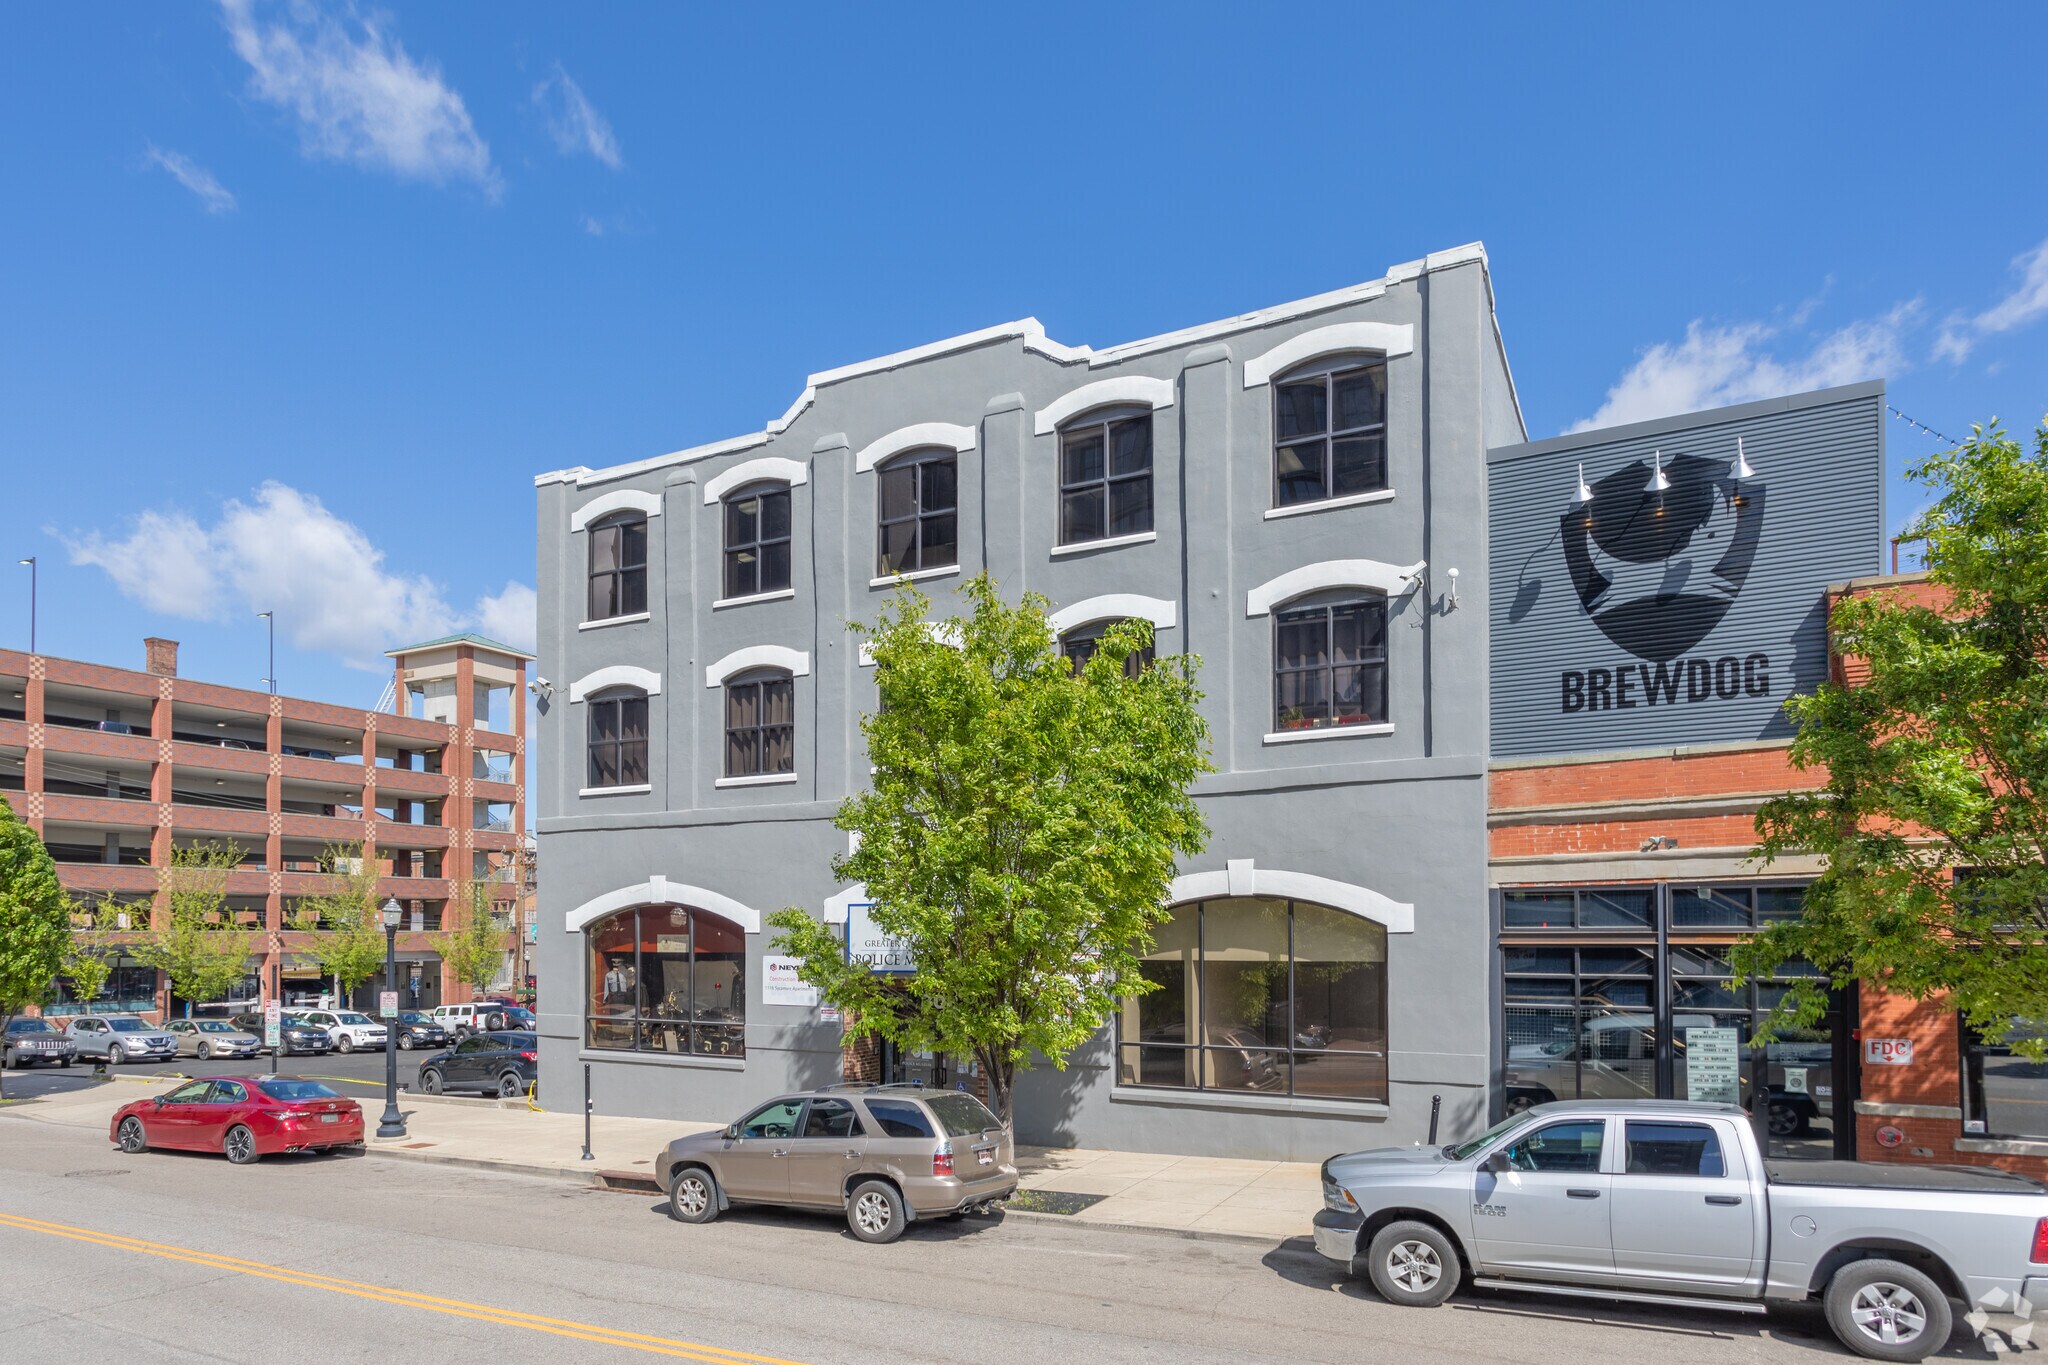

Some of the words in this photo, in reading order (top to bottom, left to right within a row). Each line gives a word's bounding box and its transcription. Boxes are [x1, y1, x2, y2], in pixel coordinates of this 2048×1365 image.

[1562, 653, 1770, 713] BREWDOG
[864, 939, 900, 948] GREATER
[855, 954, 900, 966] POLICE
[1870, 1041, 1907, 1055] FDC
[1473, 1203, 1507, 1211] RAM
